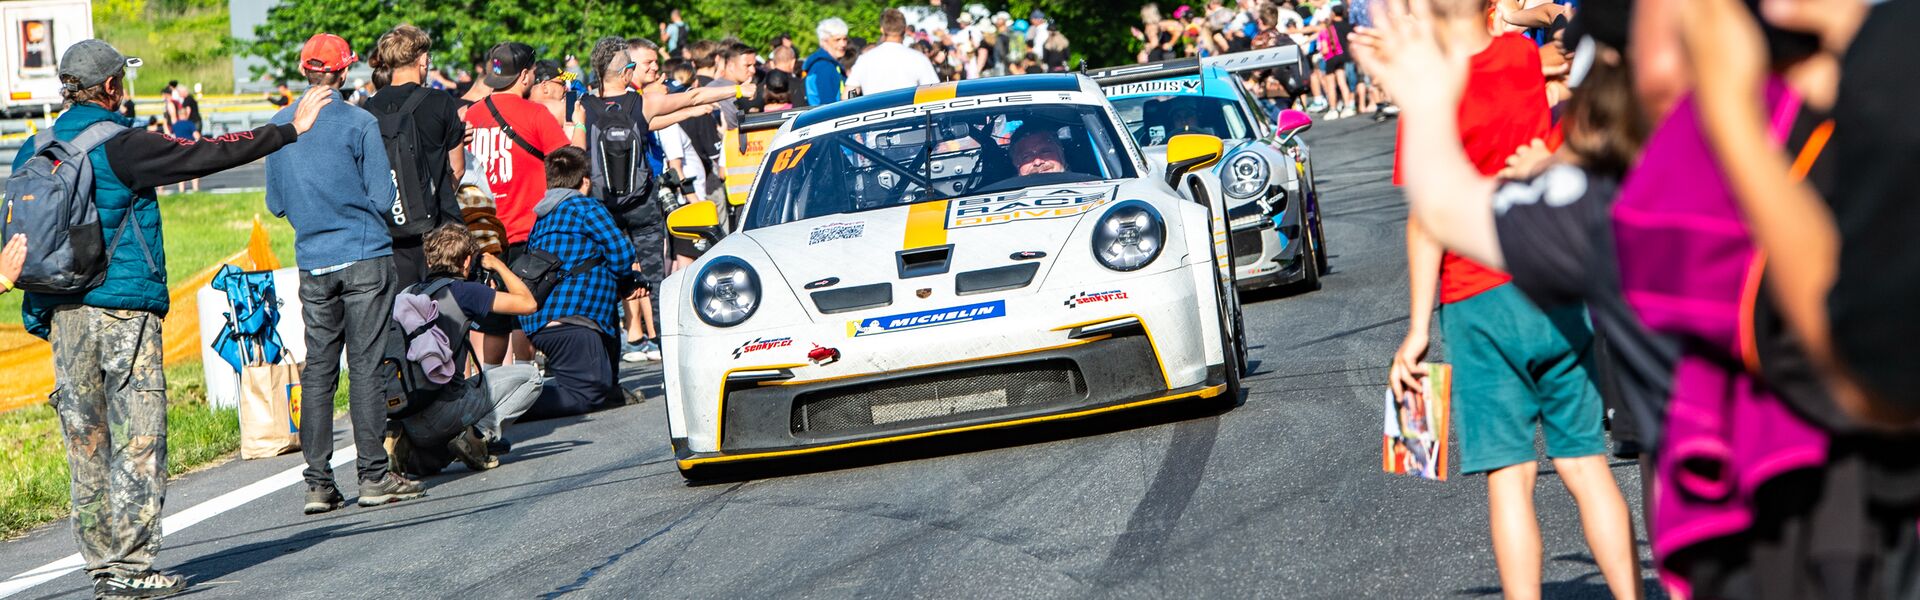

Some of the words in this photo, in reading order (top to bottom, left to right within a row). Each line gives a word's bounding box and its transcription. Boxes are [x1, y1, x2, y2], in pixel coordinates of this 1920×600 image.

[834, 94, 1033, 129] PORSCHE
[771, 143, 812, 174] 67
[955, 199, 1105, 226] DRIVER
[956, 192, 1105, 216] RACE
[1076, 292, 1129, 304] senkyr.cz
[889, 305, 995, 328] MICHELIN
[743, 340, 793, 353] senkyr.cz
